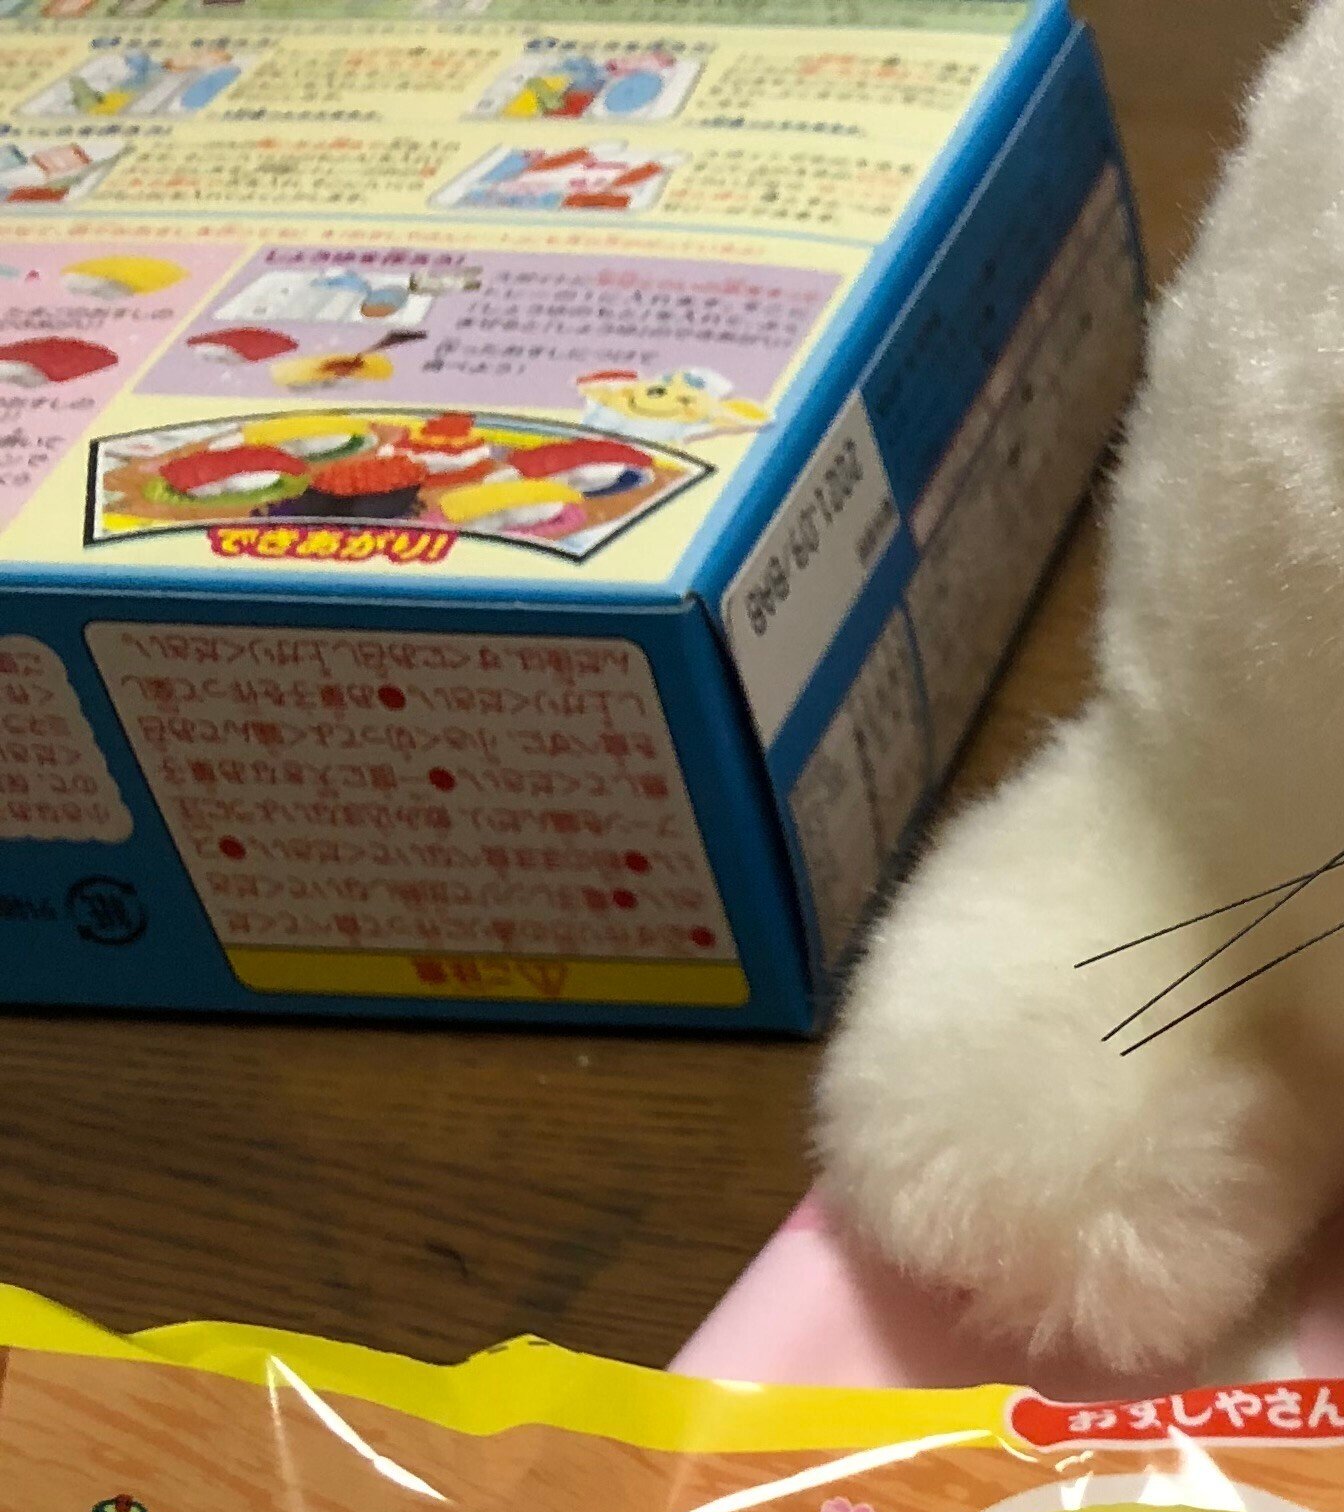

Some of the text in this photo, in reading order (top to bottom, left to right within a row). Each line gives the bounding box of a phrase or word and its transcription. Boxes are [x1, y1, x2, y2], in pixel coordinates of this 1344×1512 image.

[214, 526, 450, 563] できあがり!
